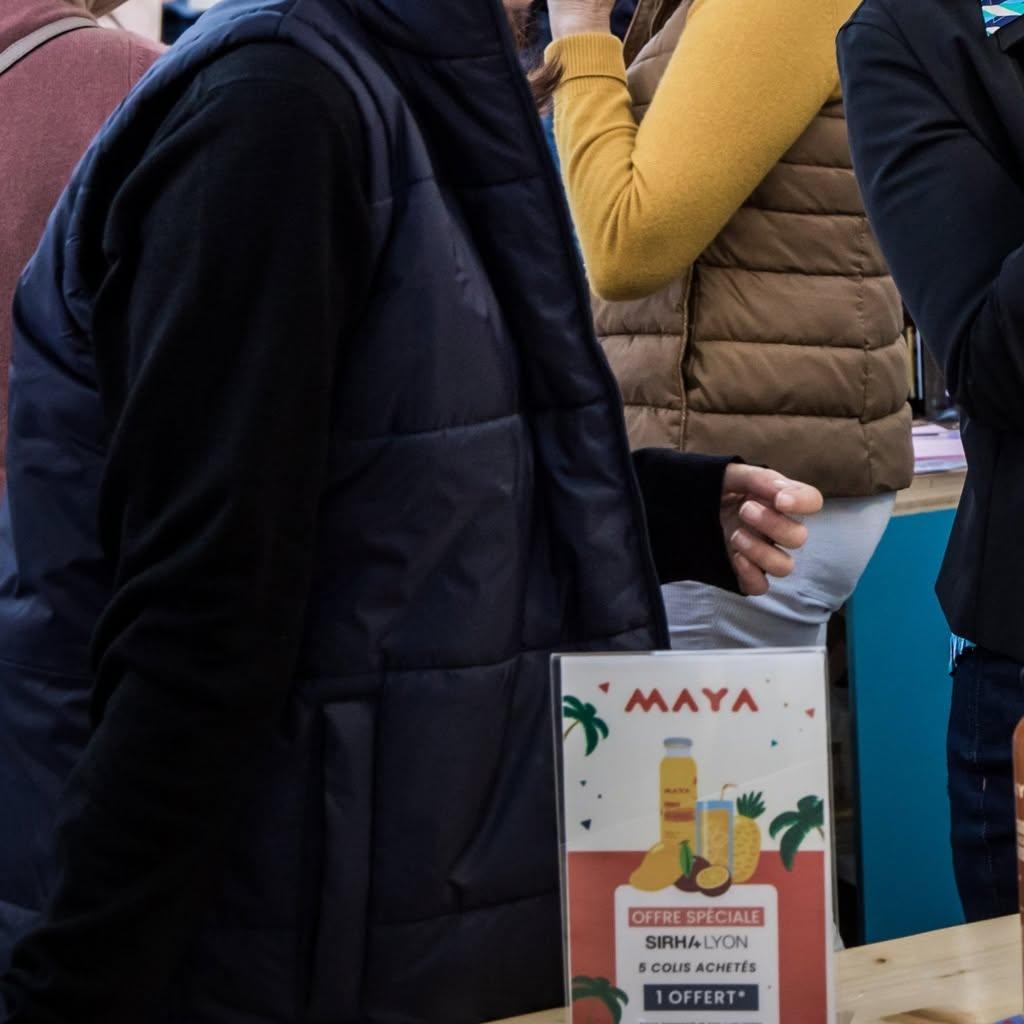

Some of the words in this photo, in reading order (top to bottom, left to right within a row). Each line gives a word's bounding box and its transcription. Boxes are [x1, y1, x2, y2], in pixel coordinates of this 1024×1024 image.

[624, 688, 759, 713] MAYA
[631, 910, 683, 924] OFFRE
[686, 907, 761, 925] SPÉCIALE
[704, 934, 748, 950] LYON
[638, 962, 647, 973] 5
[651, 962, 691, 973] COLIS
[695, 960, 757, 973] ACHETÉS
[656, 990, 662, 1005] 1
